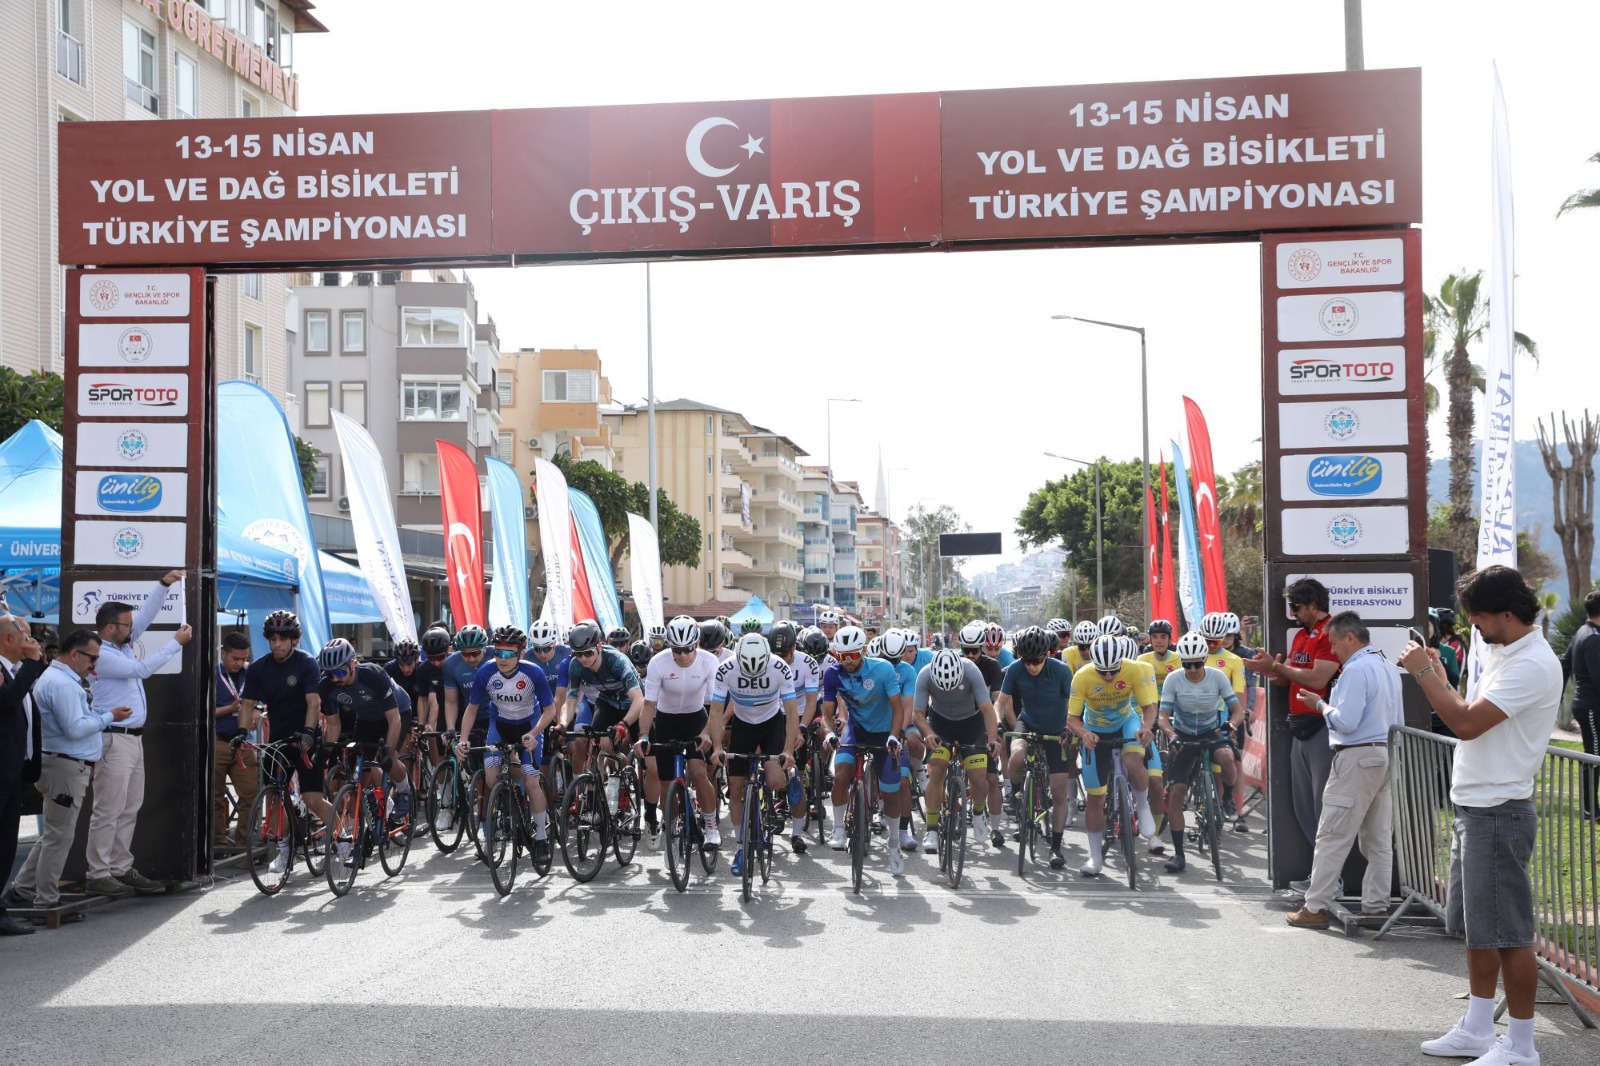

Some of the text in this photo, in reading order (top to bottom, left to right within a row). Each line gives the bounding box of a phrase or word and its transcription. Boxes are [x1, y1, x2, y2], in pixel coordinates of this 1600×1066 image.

[1069, 91, 1290, 128] 13-15 NİSAN
[175, 128, 374, 159] 13-15 NİSAN
[976, 128, 1386, 176] YOL VE DAĞ BİSİKLETİ
[90, 165, 459, 203] YOL VE DAĞ BİSİKLETİ
[569, 179, 861, 236] ÇIKIŞ-VARIŞ
[969, 179, 1395, 220] TÜRKİYE ŞAMPİYONASI
[83, 211, 466, 248] TÜRKİYE ŞAMPİYONASI
[107, 592, 141, 600] TÜRKİYE
[1367, 586, 1408, 594] BİSİKLET
[715, 660, 735, 682] DEU
[773, 660, 792, 680] DEU
[803, 655, 819, 675] DEU
[738, 677, 770, 689] DEU
[496, 693, 523, 702] KMÜ
